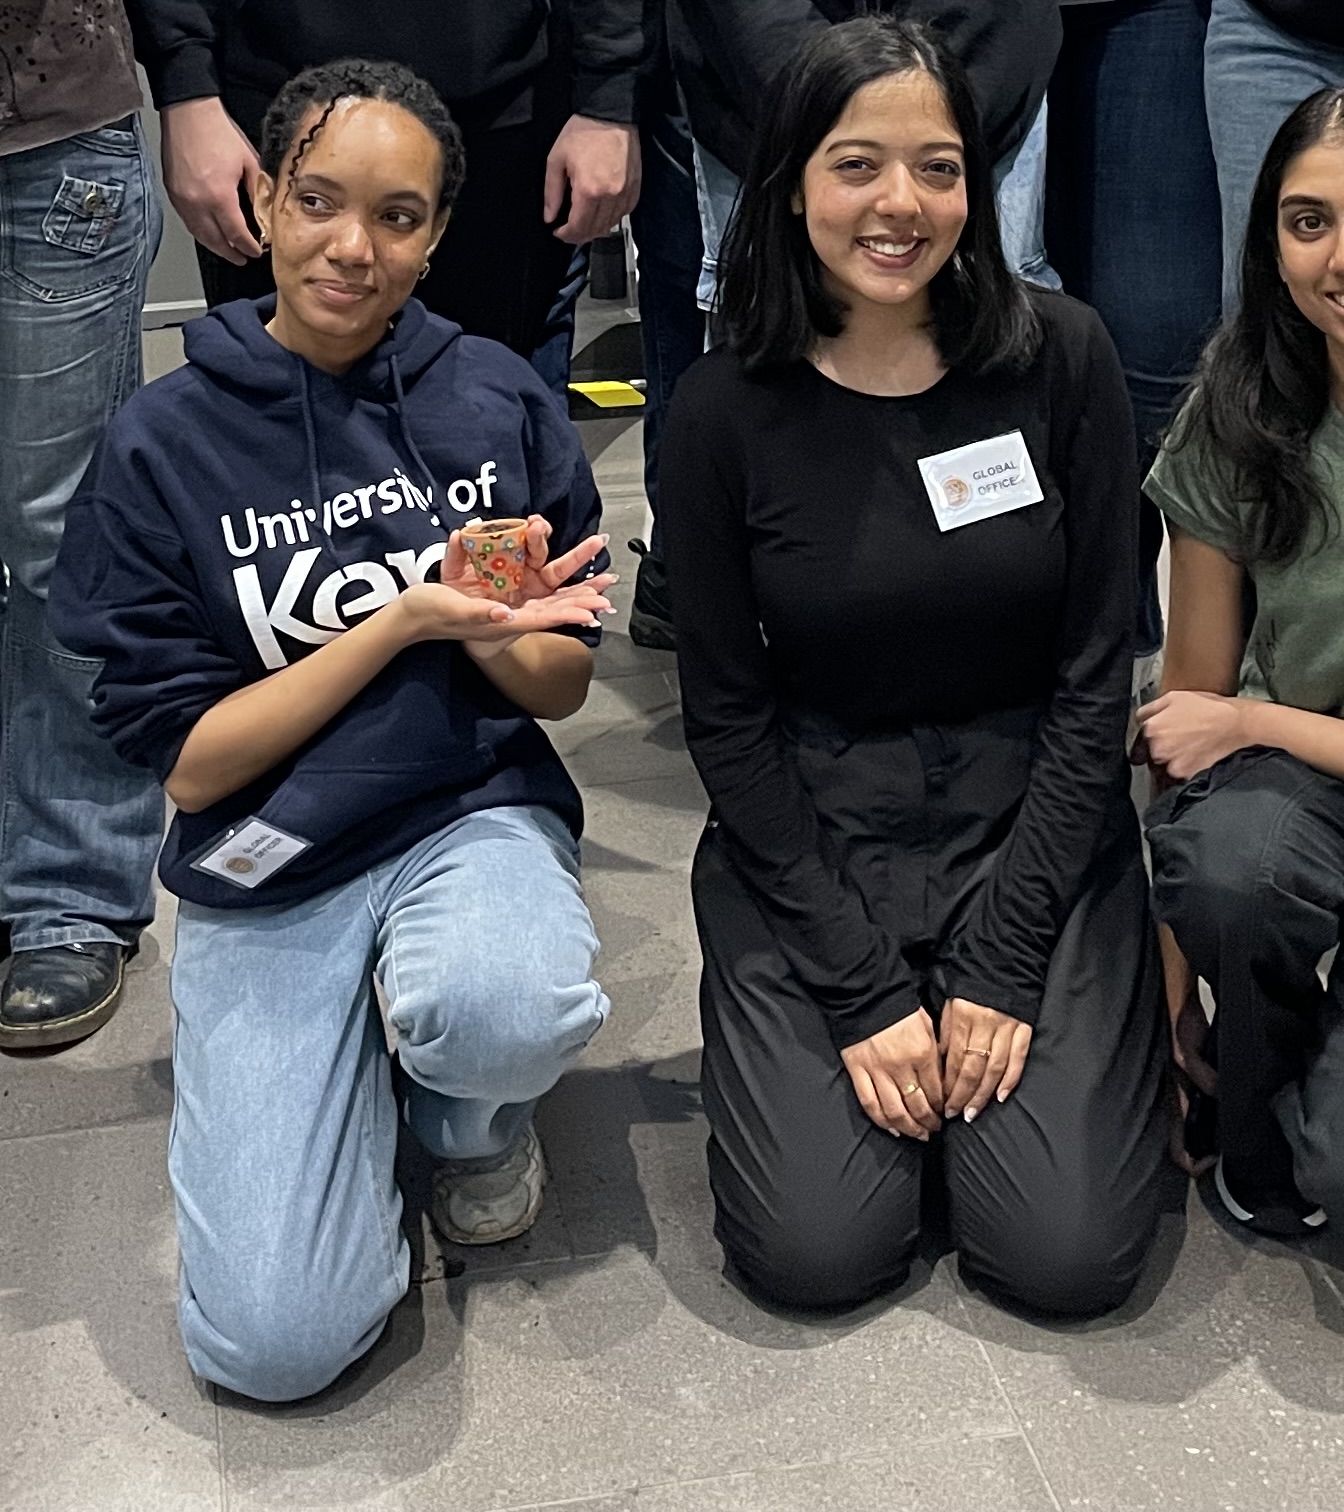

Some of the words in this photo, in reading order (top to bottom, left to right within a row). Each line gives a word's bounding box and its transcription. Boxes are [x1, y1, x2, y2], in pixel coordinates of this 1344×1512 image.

[447, 460, 498, 513] of
[972, 461, 1017, 480] GLOBAL
[232, 538, 449, 670] Ken
